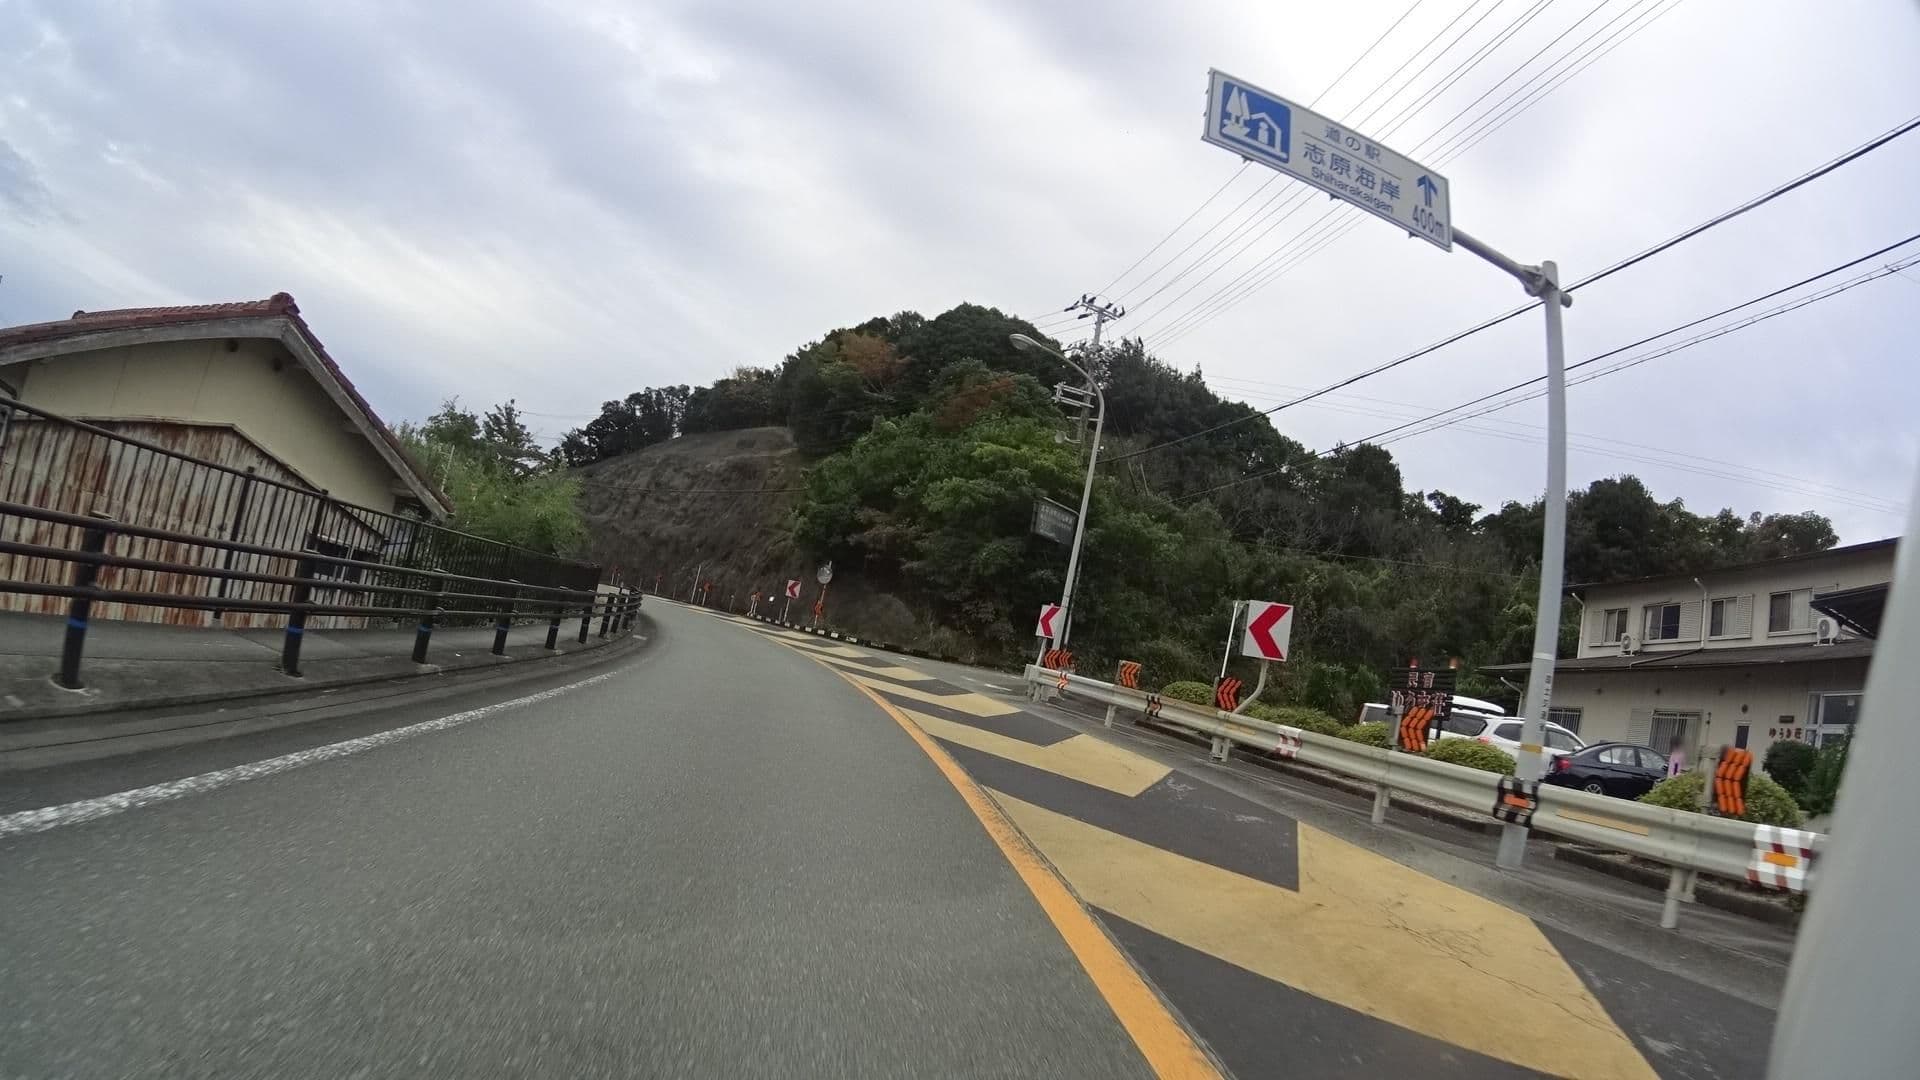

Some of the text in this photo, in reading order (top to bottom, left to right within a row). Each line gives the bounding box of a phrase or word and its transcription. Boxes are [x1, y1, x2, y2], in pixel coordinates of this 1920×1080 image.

[1326, 126, 1382, 163] 道の駅
[1304, 142, 1401, 202] 志原海岸
[1412, 204, 1445, 241] 400m
[1406, 671, 1436, 689] 民宿
